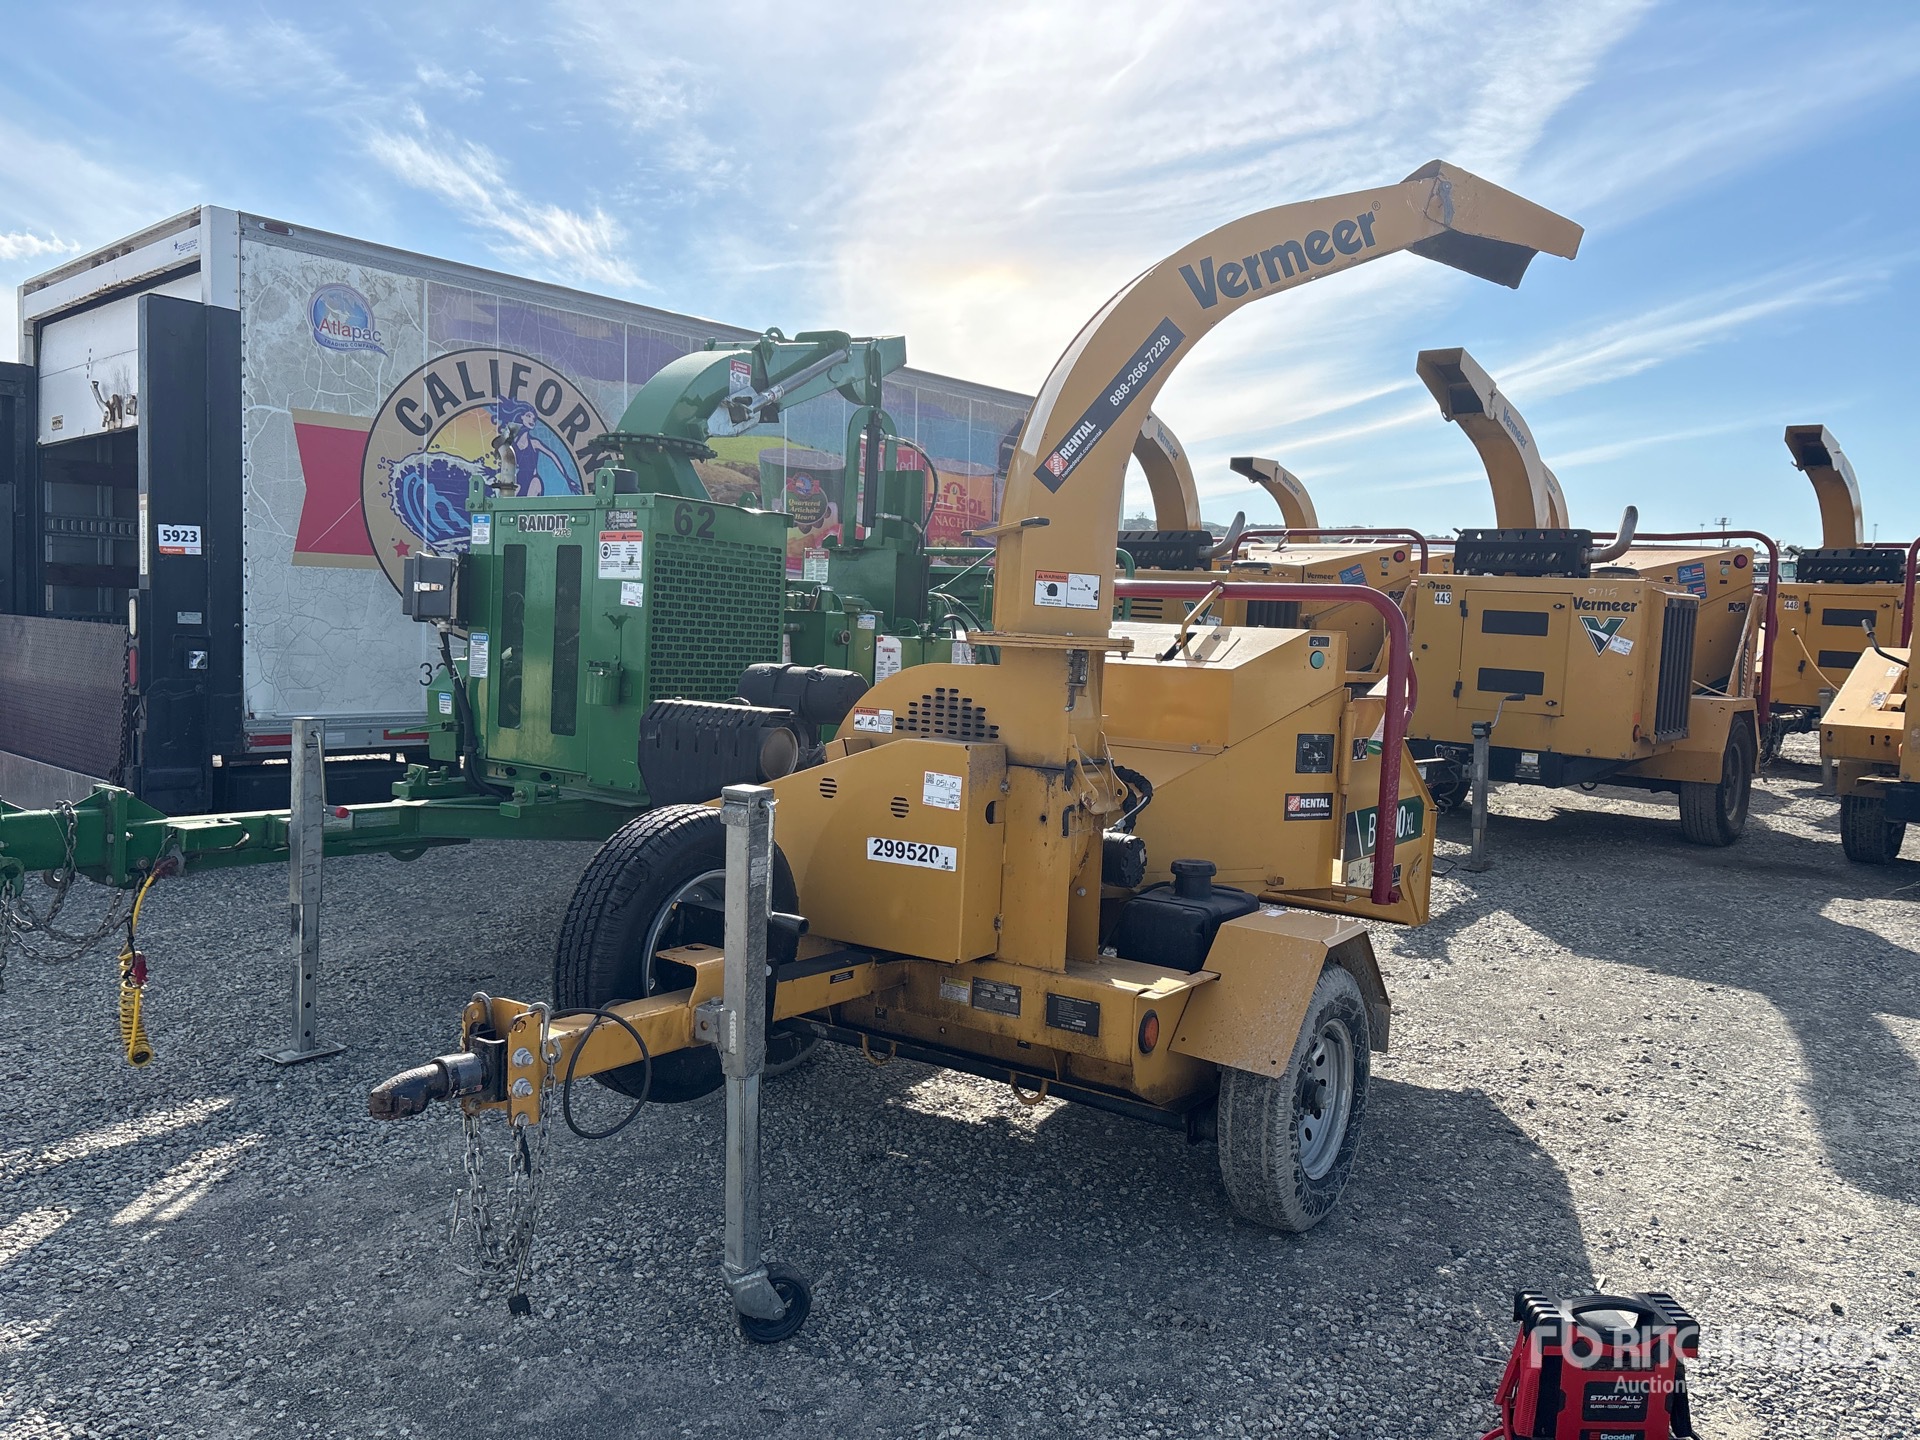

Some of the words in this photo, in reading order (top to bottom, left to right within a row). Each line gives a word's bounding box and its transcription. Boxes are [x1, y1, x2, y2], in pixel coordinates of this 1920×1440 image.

[1178, 211, 1376, 310] Vermeer
[319, 318, 382, 343] Atlapac
[324, 339, 349, 348] TRADING
[1109, 334, 1171, 406] 888-266-7228
[1502, 406, 1527, 449] Vermeer
[1059, 420, 1097, 460] RENTAL
[1157, 424, 1179, 461] Vermeer
[788, 499, 821, 507] Quartered
[789, 506, 820, 514] Artichoke
[956, 497, 986, 517] SOL
[518, 514, 570, 532] BANDIT
[674, 502, 715, 539] 62
[935, 515, 979, 529] NACHOS
[162, 529, 198, 543] 5923
[1306, 572, 1334, 580] Vermeer
[1434, 592, 1452, 604] 443
[1572, 596, 1638, 612] Vermeer
[1300, 798, 1330, 809] RENTAL
[872, 838, 940, 864] 299520
